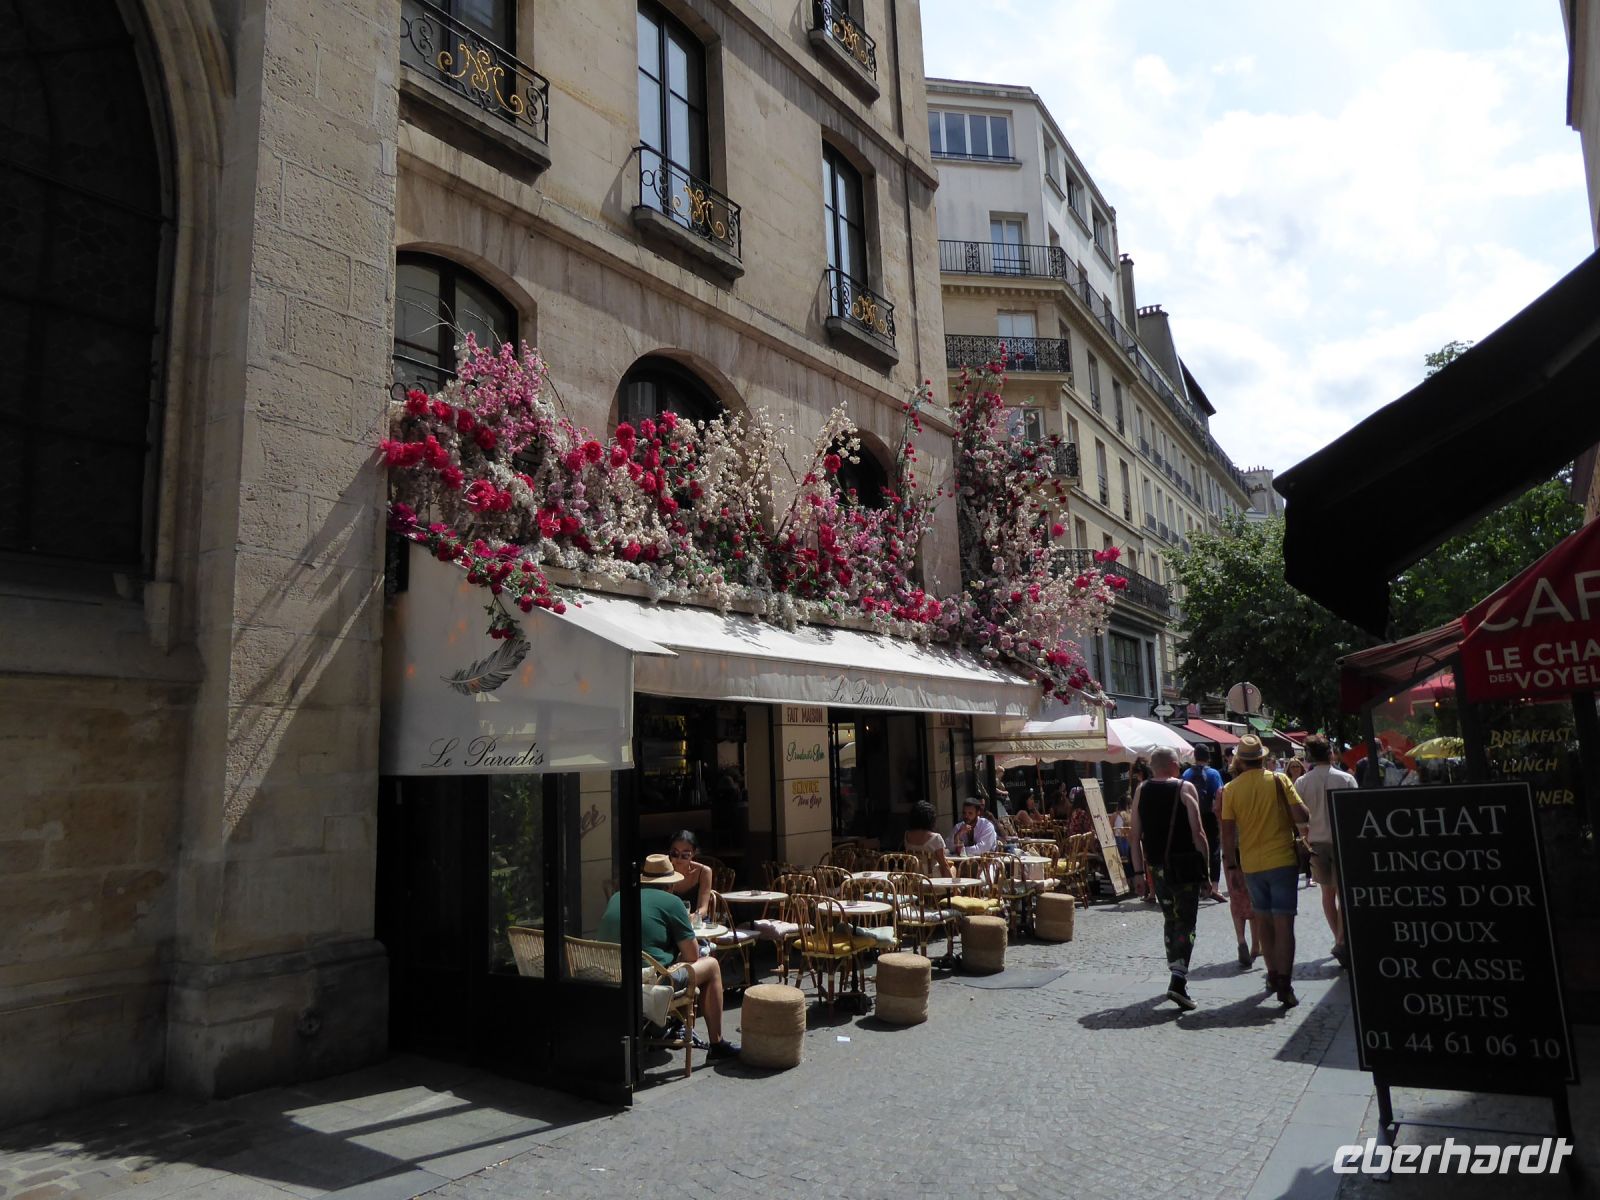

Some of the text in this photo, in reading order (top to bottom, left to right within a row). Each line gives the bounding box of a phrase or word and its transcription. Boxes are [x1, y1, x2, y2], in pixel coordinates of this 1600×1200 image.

[1485, 646, 1523, 671] LE
[825, 674, 893, 706] Le Paradis
[1488, 672, 1513, 684] DES
[786, 706, 823, 723] FAIT MAISON
[1488, 727, 1573, 749] BREAKFAST
[422, 735, 546, 769] Le Paradis
[1502, 757, 1559, 773] LUNCH
[792, 780, 820, 795] SERVICE
[1535, 788, 1575, 807] NER
[1356, 804, 1507, 839] ACHAT
[1371, 848, 1503, 873] LINGOTS
[1351, 884, 1537, 908] PIECES D'OR
[1392, 920, 1500, 949] BIJOUX
[1378, 957, 1526, 983] OR CASSE
[1402, 992, 1510, 1022] OBJETS
[1365, 1029, 1561, 1060] 01 44 61 06 10
